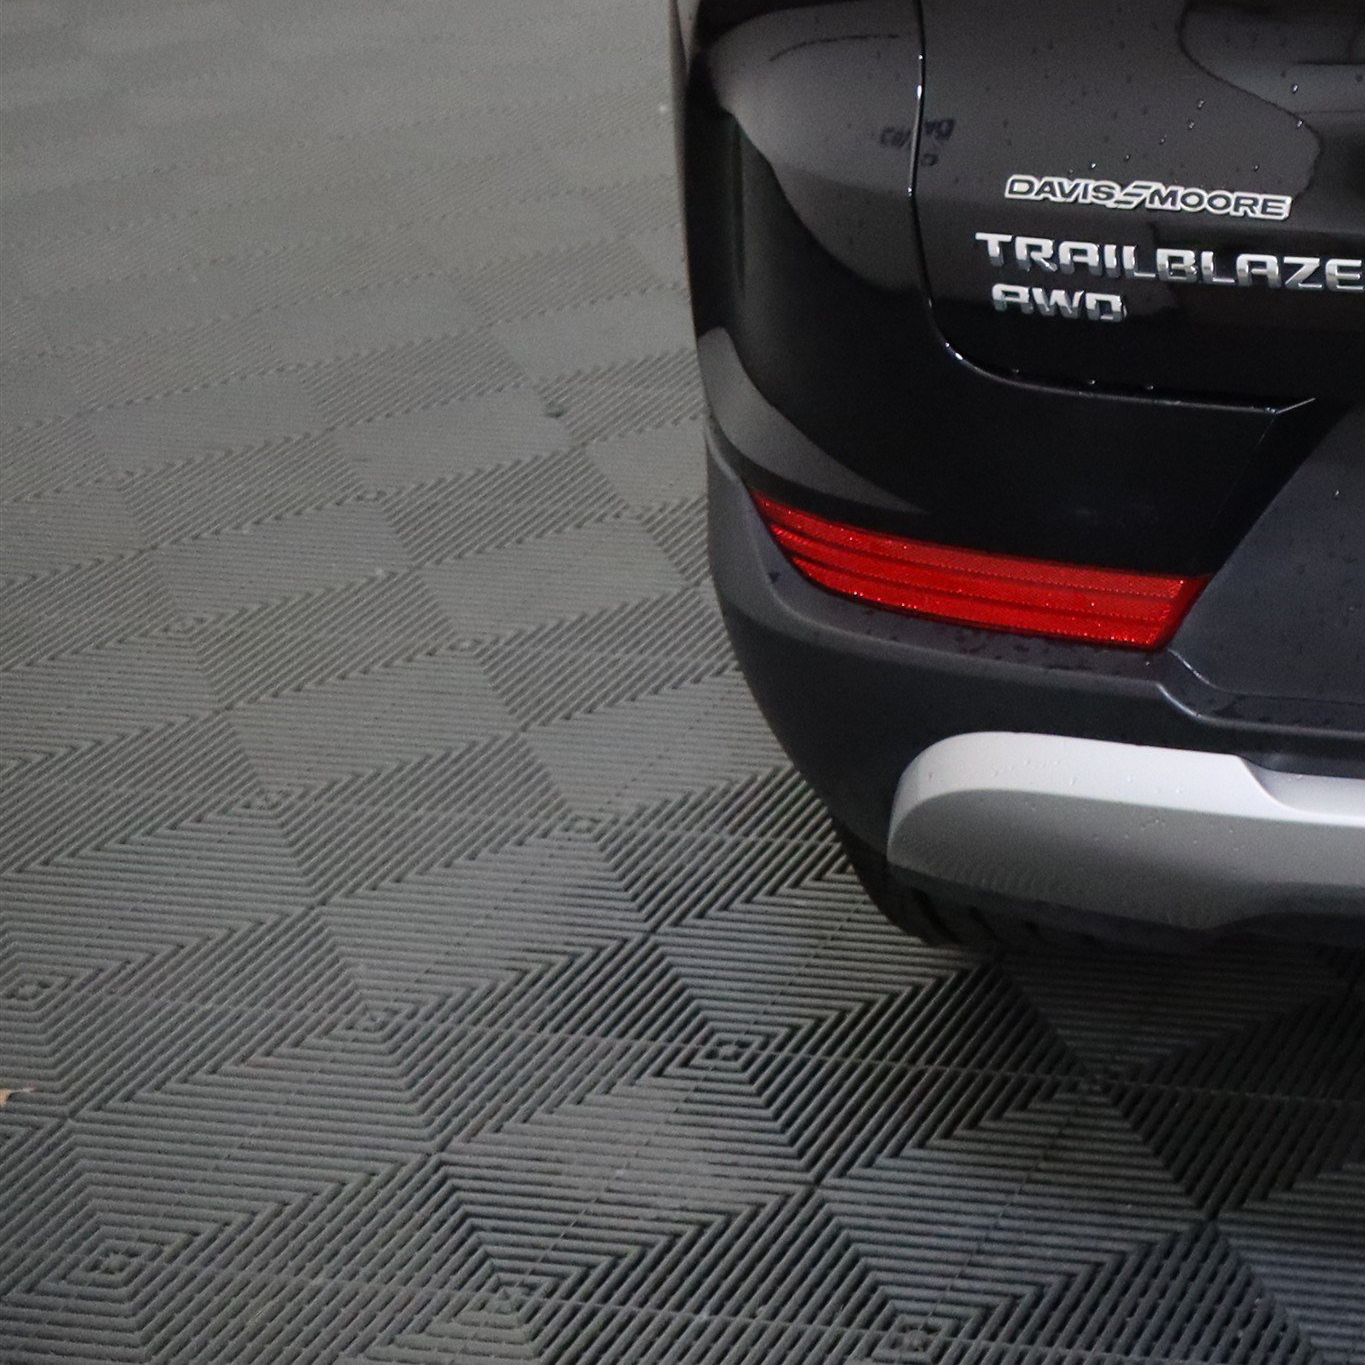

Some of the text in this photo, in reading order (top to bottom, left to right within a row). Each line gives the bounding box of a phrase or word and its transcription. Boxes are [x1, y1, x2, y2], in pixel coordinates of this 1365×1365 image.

[1006, 176, 1292, 219] DAVIS MOORE
[992, 284, 1128, 323] AWD
